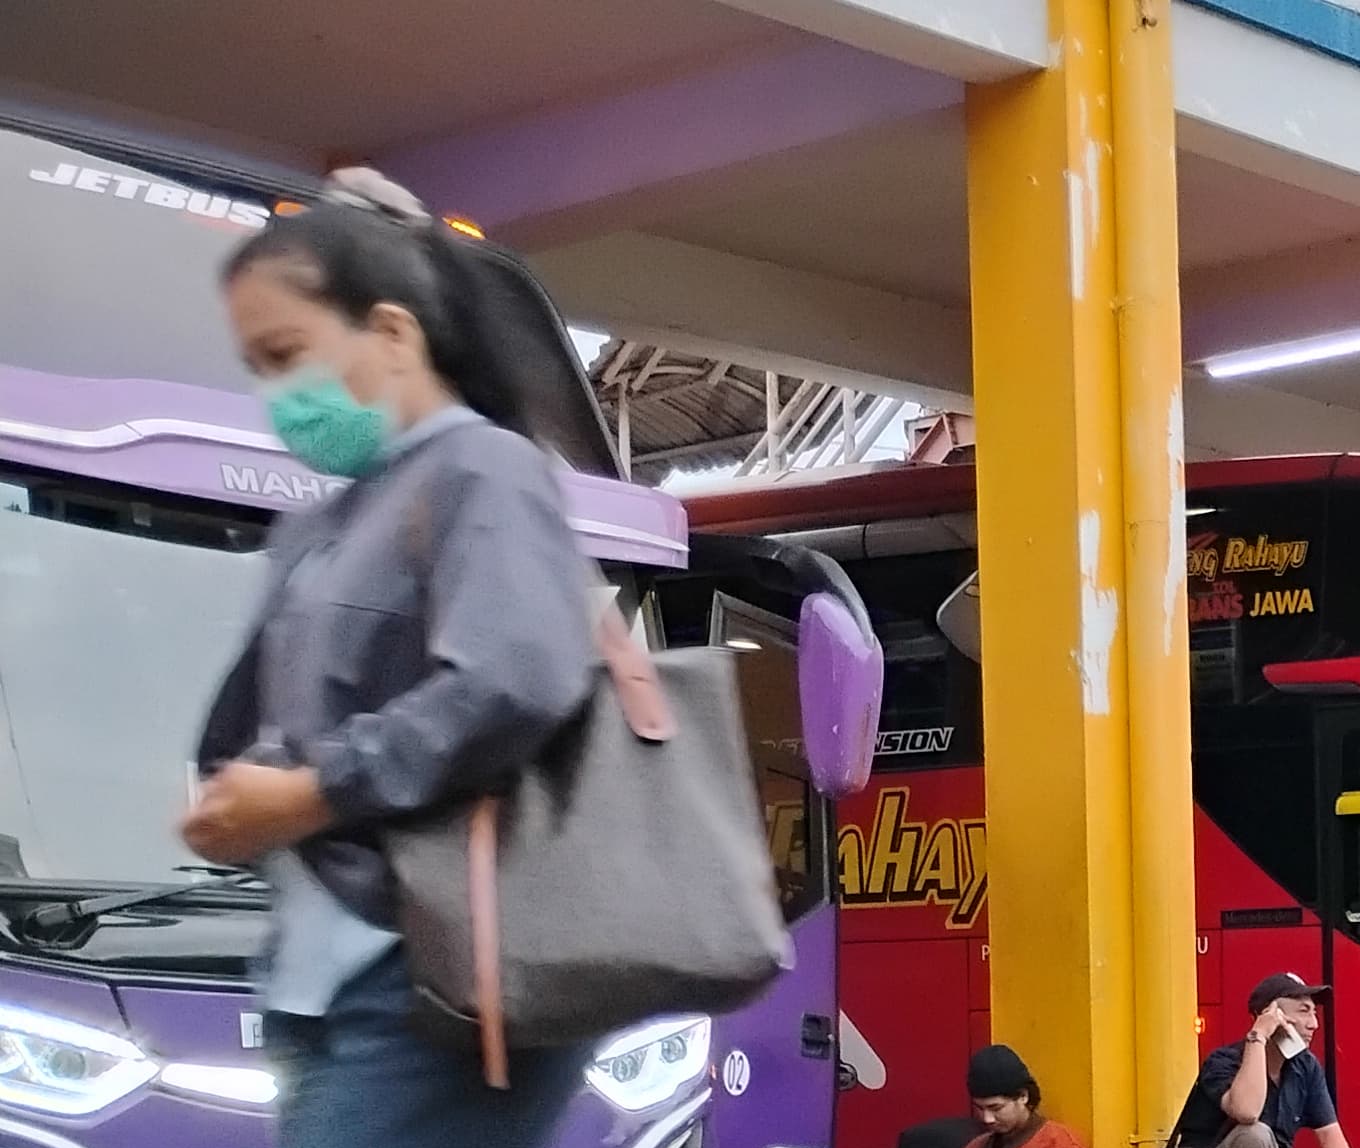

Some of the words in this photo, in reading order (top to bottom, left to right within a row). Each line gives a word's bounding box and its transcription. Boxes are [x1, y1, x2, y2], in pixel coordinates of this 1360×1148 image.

[29, 163, 271, 229] JETBUS
[1250, 588, 1315, 618] JAWA
[728, 1054, 745, 1091] 02
